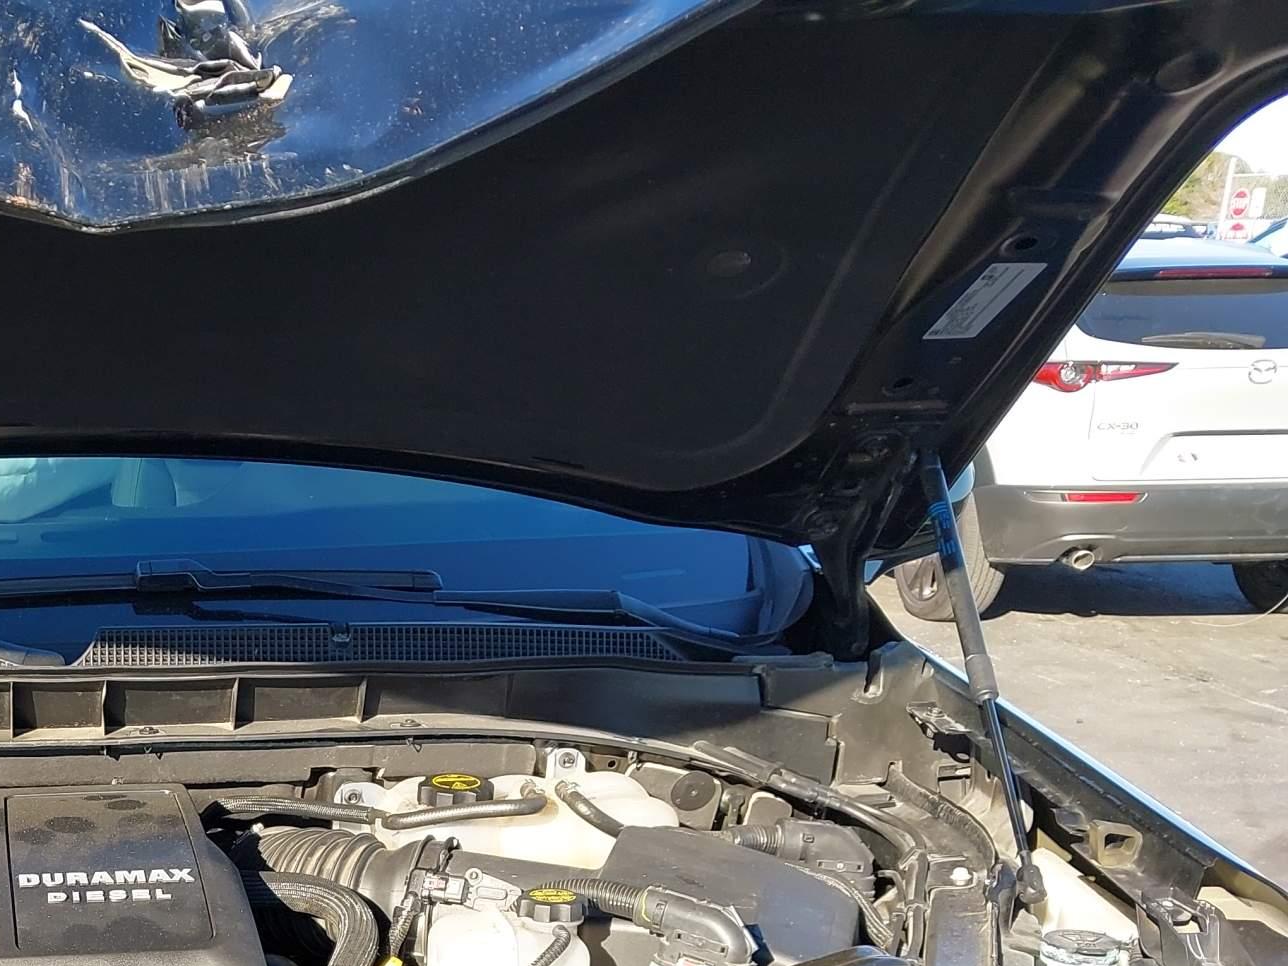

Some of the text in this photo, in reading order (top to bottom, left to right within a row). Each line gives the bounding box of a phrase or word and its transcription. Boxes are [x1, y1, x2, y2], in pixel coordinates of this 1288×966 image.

[1096, 421, 1139, 431] CX-30
[17, 868, 196, 888] DURAMAX
[47, 888, 173, 904] DIESEL
